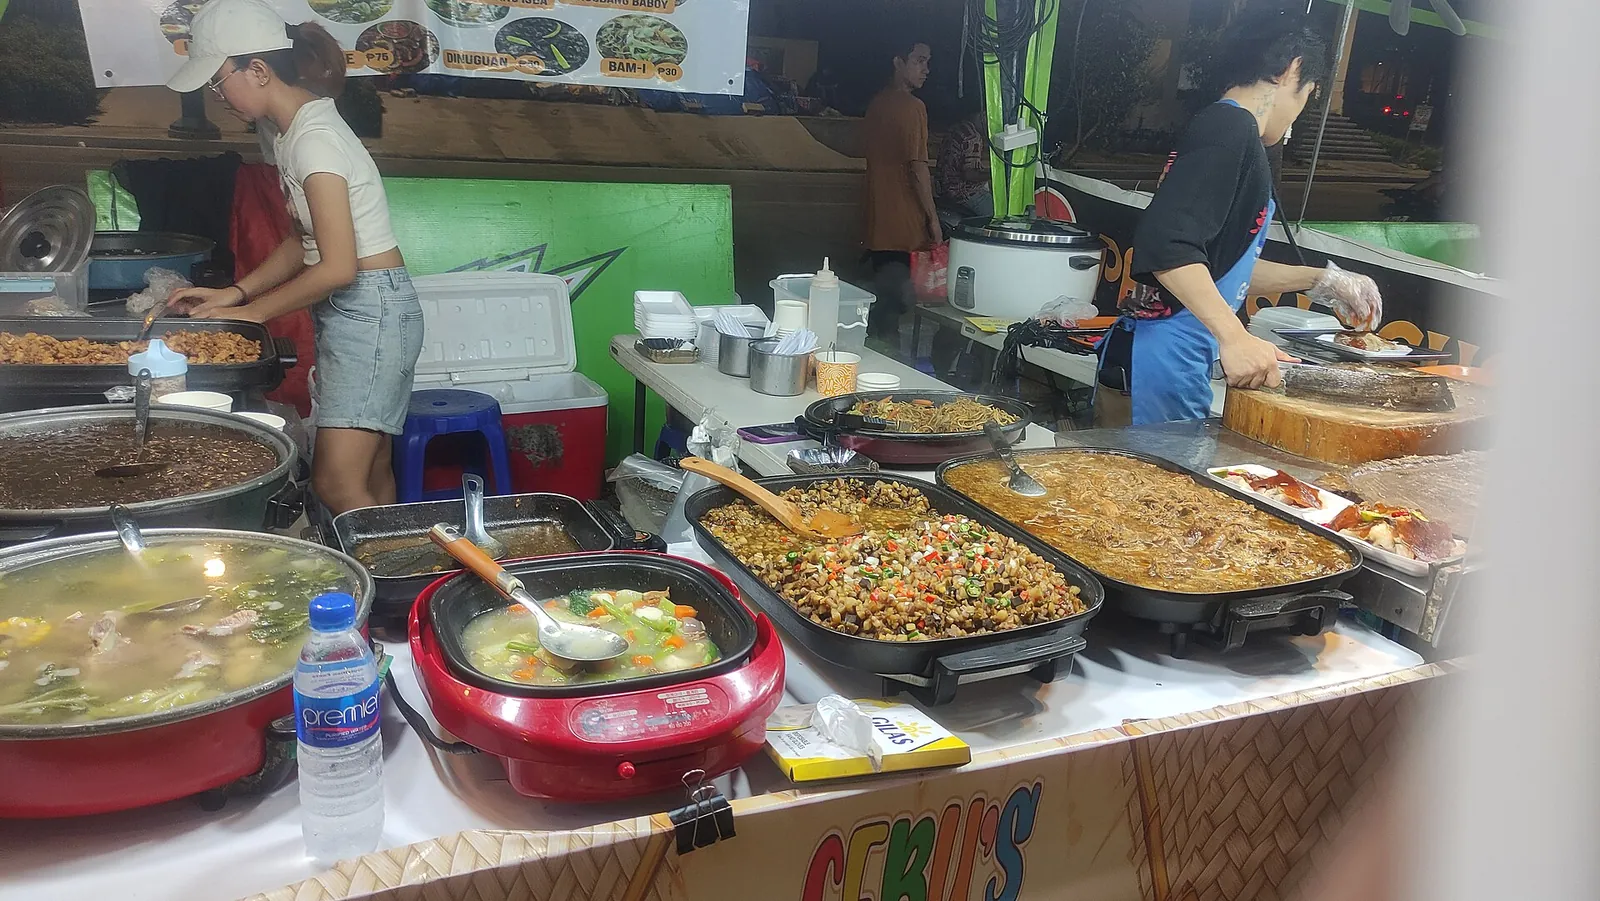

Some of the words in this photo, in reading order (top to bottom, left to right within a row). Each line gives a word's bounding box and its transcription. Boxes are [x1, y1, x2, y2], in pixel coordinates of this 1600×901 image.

[446, 52, 508, 67] DINUGUAN
[608, 61, 646, 74] BAM-I
[302, 690, 379, 728] premier
[871, 717, 914, 745] GILAS
